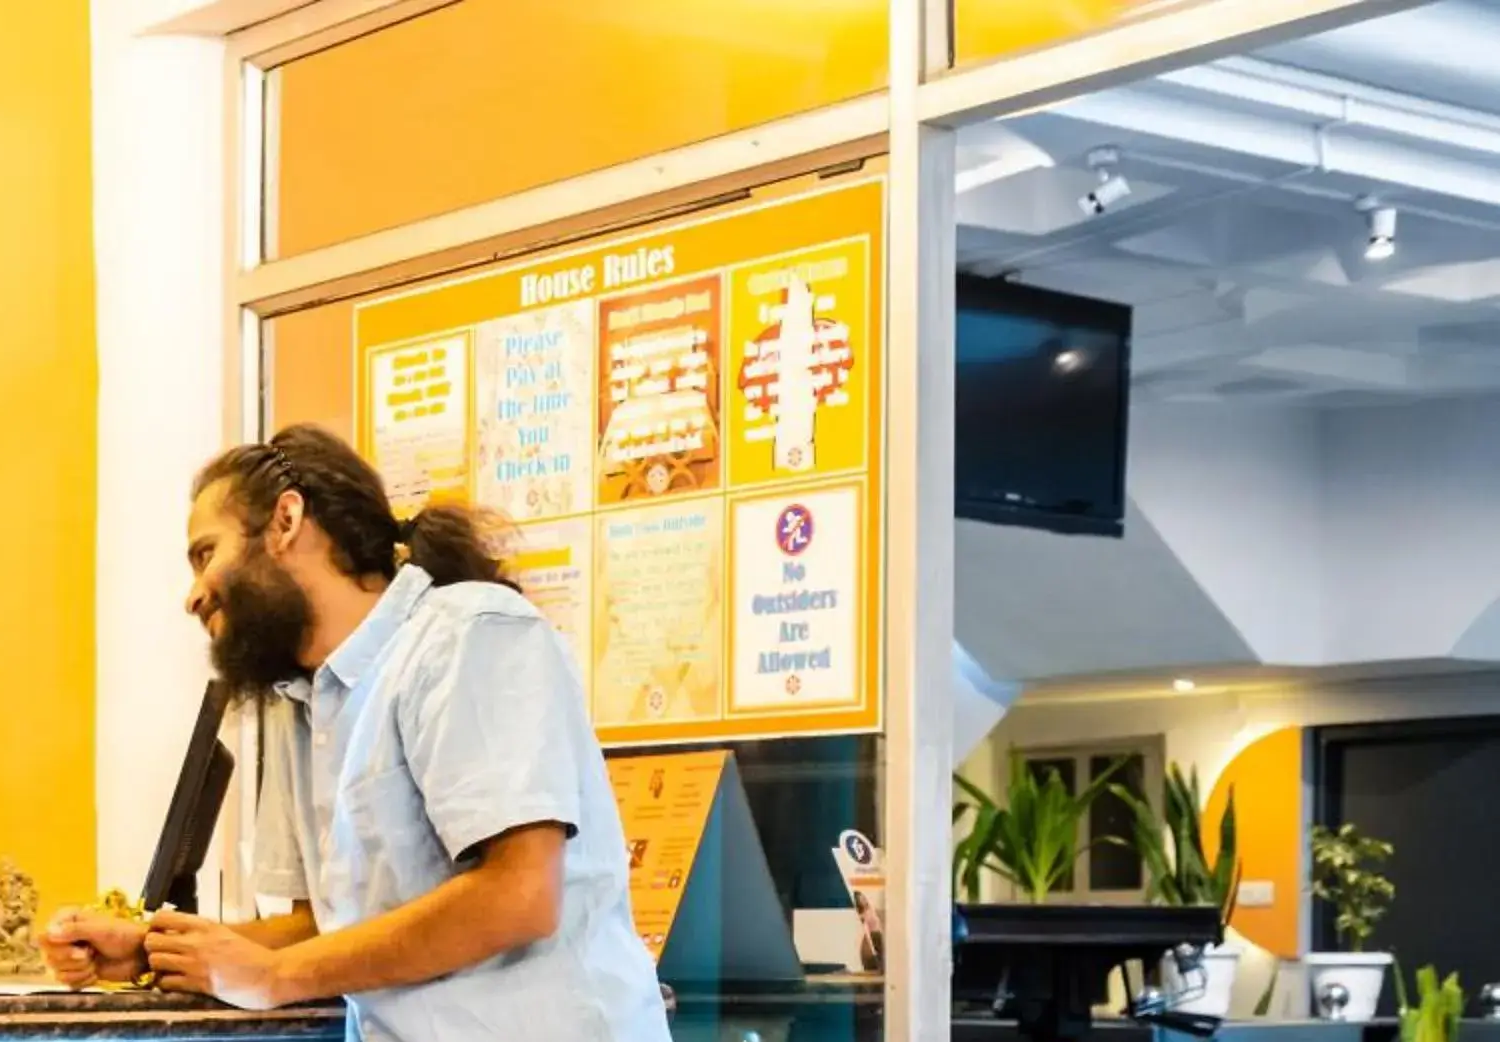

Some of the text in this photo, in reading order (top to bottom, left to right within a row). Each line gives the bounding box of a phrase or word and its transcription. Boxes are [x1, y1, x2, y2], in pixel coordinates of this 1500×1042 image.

[520, 245, 675, 307] House Rules
[506, 331, 563, 358] Please
[507, 365, 536, 388] Pay
[782, 561, 806, 584] No
[752, 589, 838, 615] Outsiders
[779, 621, 809, 643] Are
[757, 648, 831, 674] Allowed
